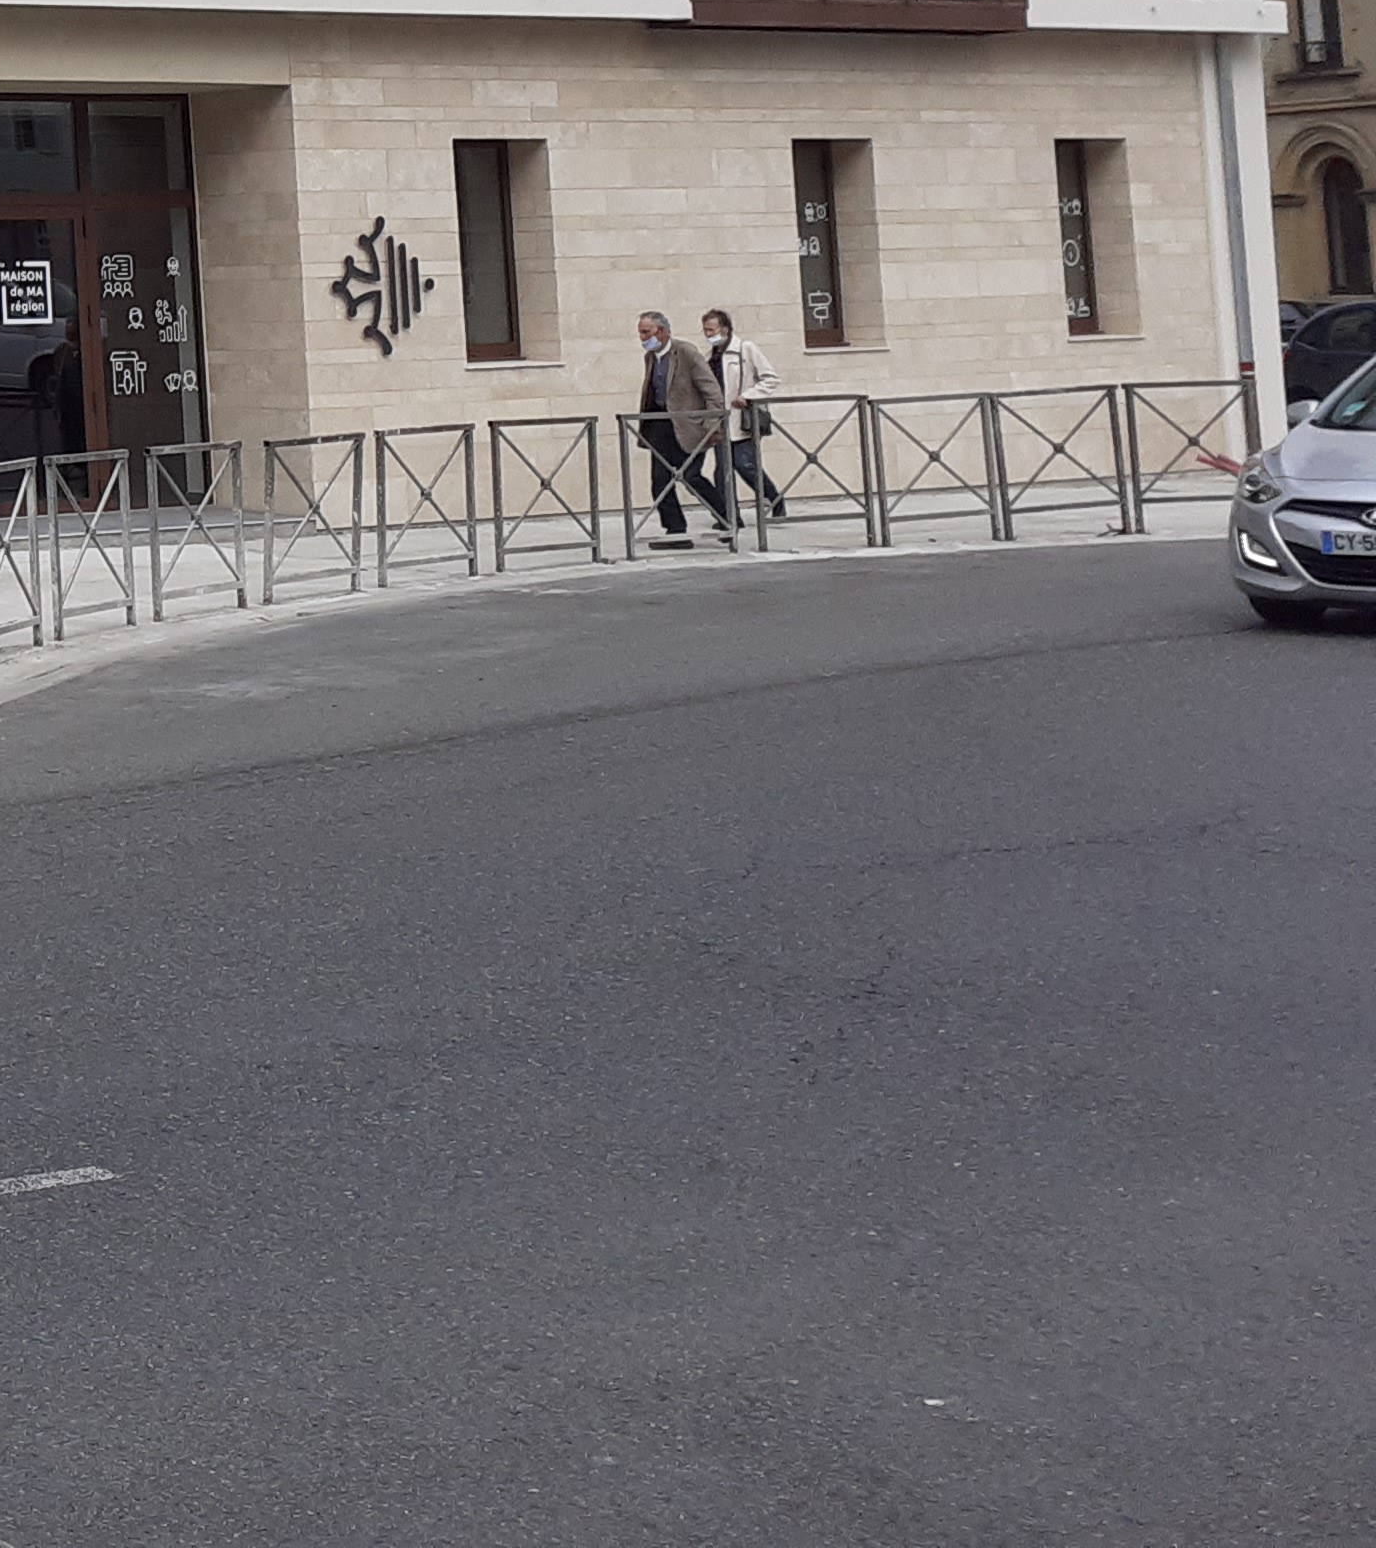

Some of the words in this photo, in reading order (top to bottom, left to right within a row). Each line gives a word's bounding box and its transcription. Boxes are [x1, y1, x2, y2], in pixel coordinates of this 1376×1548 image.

[0, 270, 44, 282] MAISON
[9, 285, 24, 297] de
[26, 285, 45, 297] MA
[10, 299, 45, 315] région
[1334, 534, 1376, 551] CY-5
